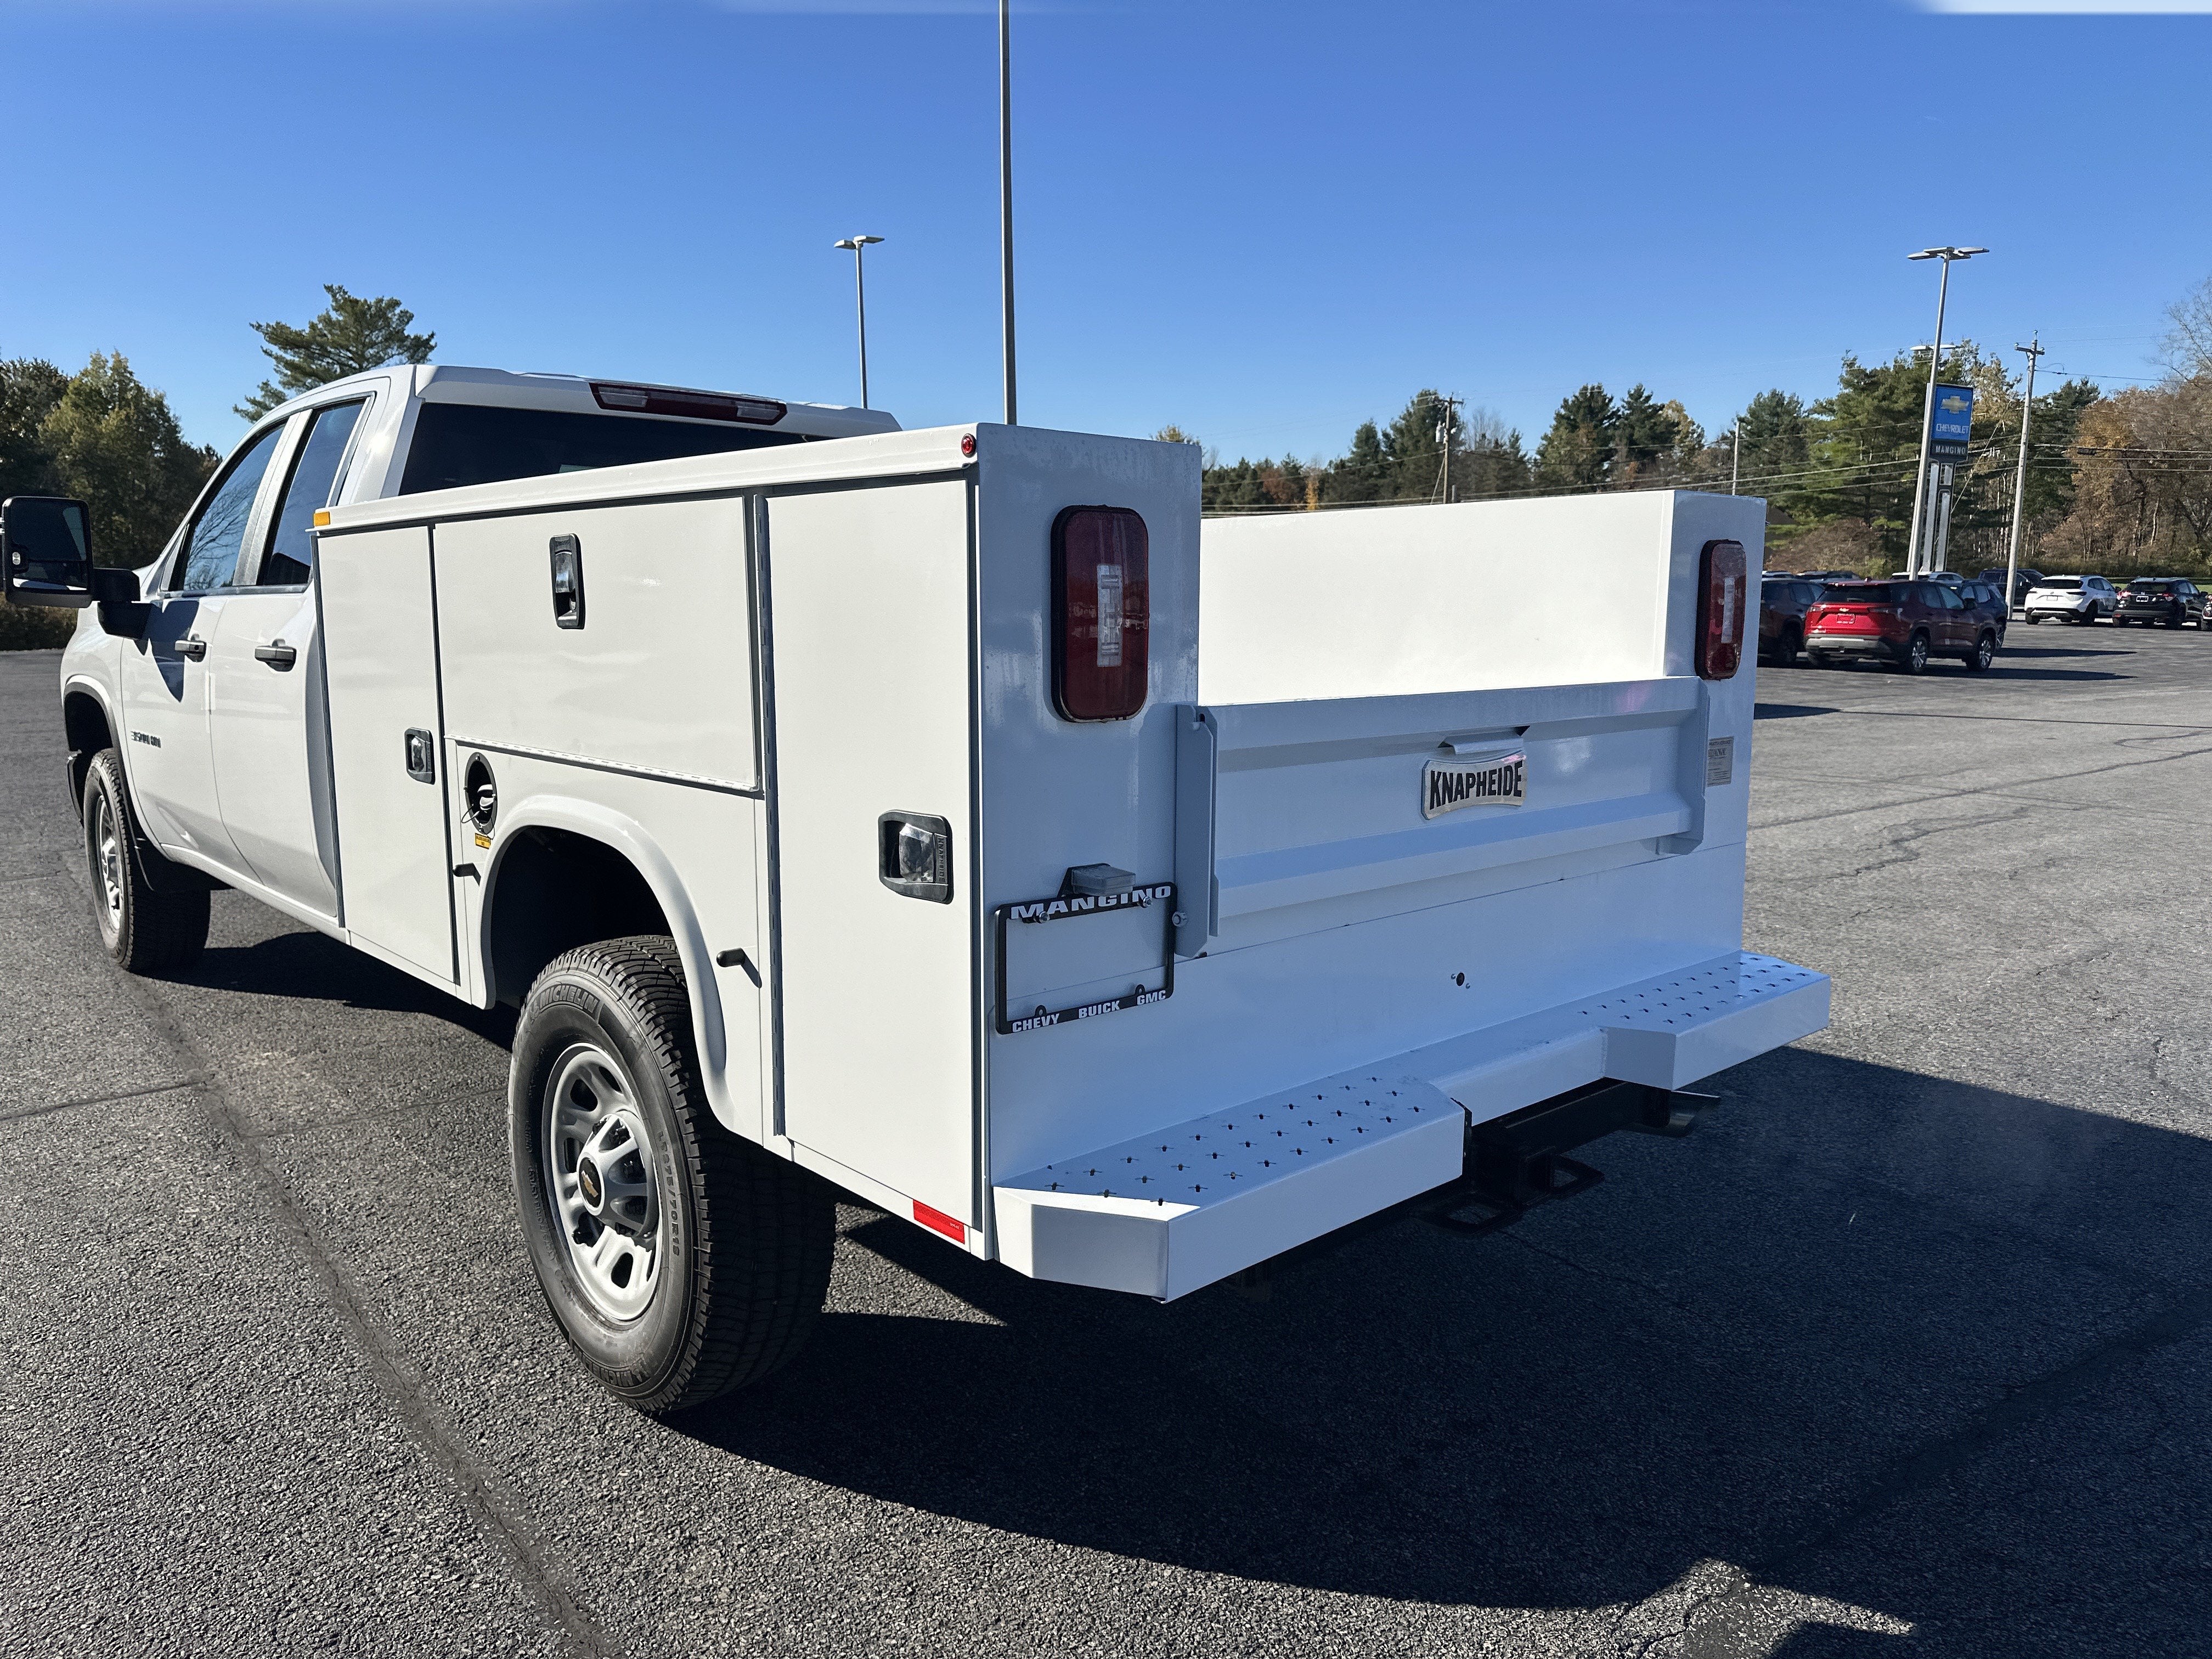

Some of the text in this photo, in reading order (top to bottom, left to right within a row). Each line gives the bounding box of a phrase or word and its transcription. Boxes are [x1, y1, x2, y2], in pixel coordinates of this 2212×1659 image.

[1936, 445, 1966, 454] MANGINO
[1430, 760, 1523, 810] KNAPHEIDE
[1011, 885, 1171, 920] MANGINO
[540, 985, 599, 1013] MICHELIN
[1012, 990, 1166, 1032] CHEVY BUICK GMC
[574, 1346, 634, 1387] MICHEL
